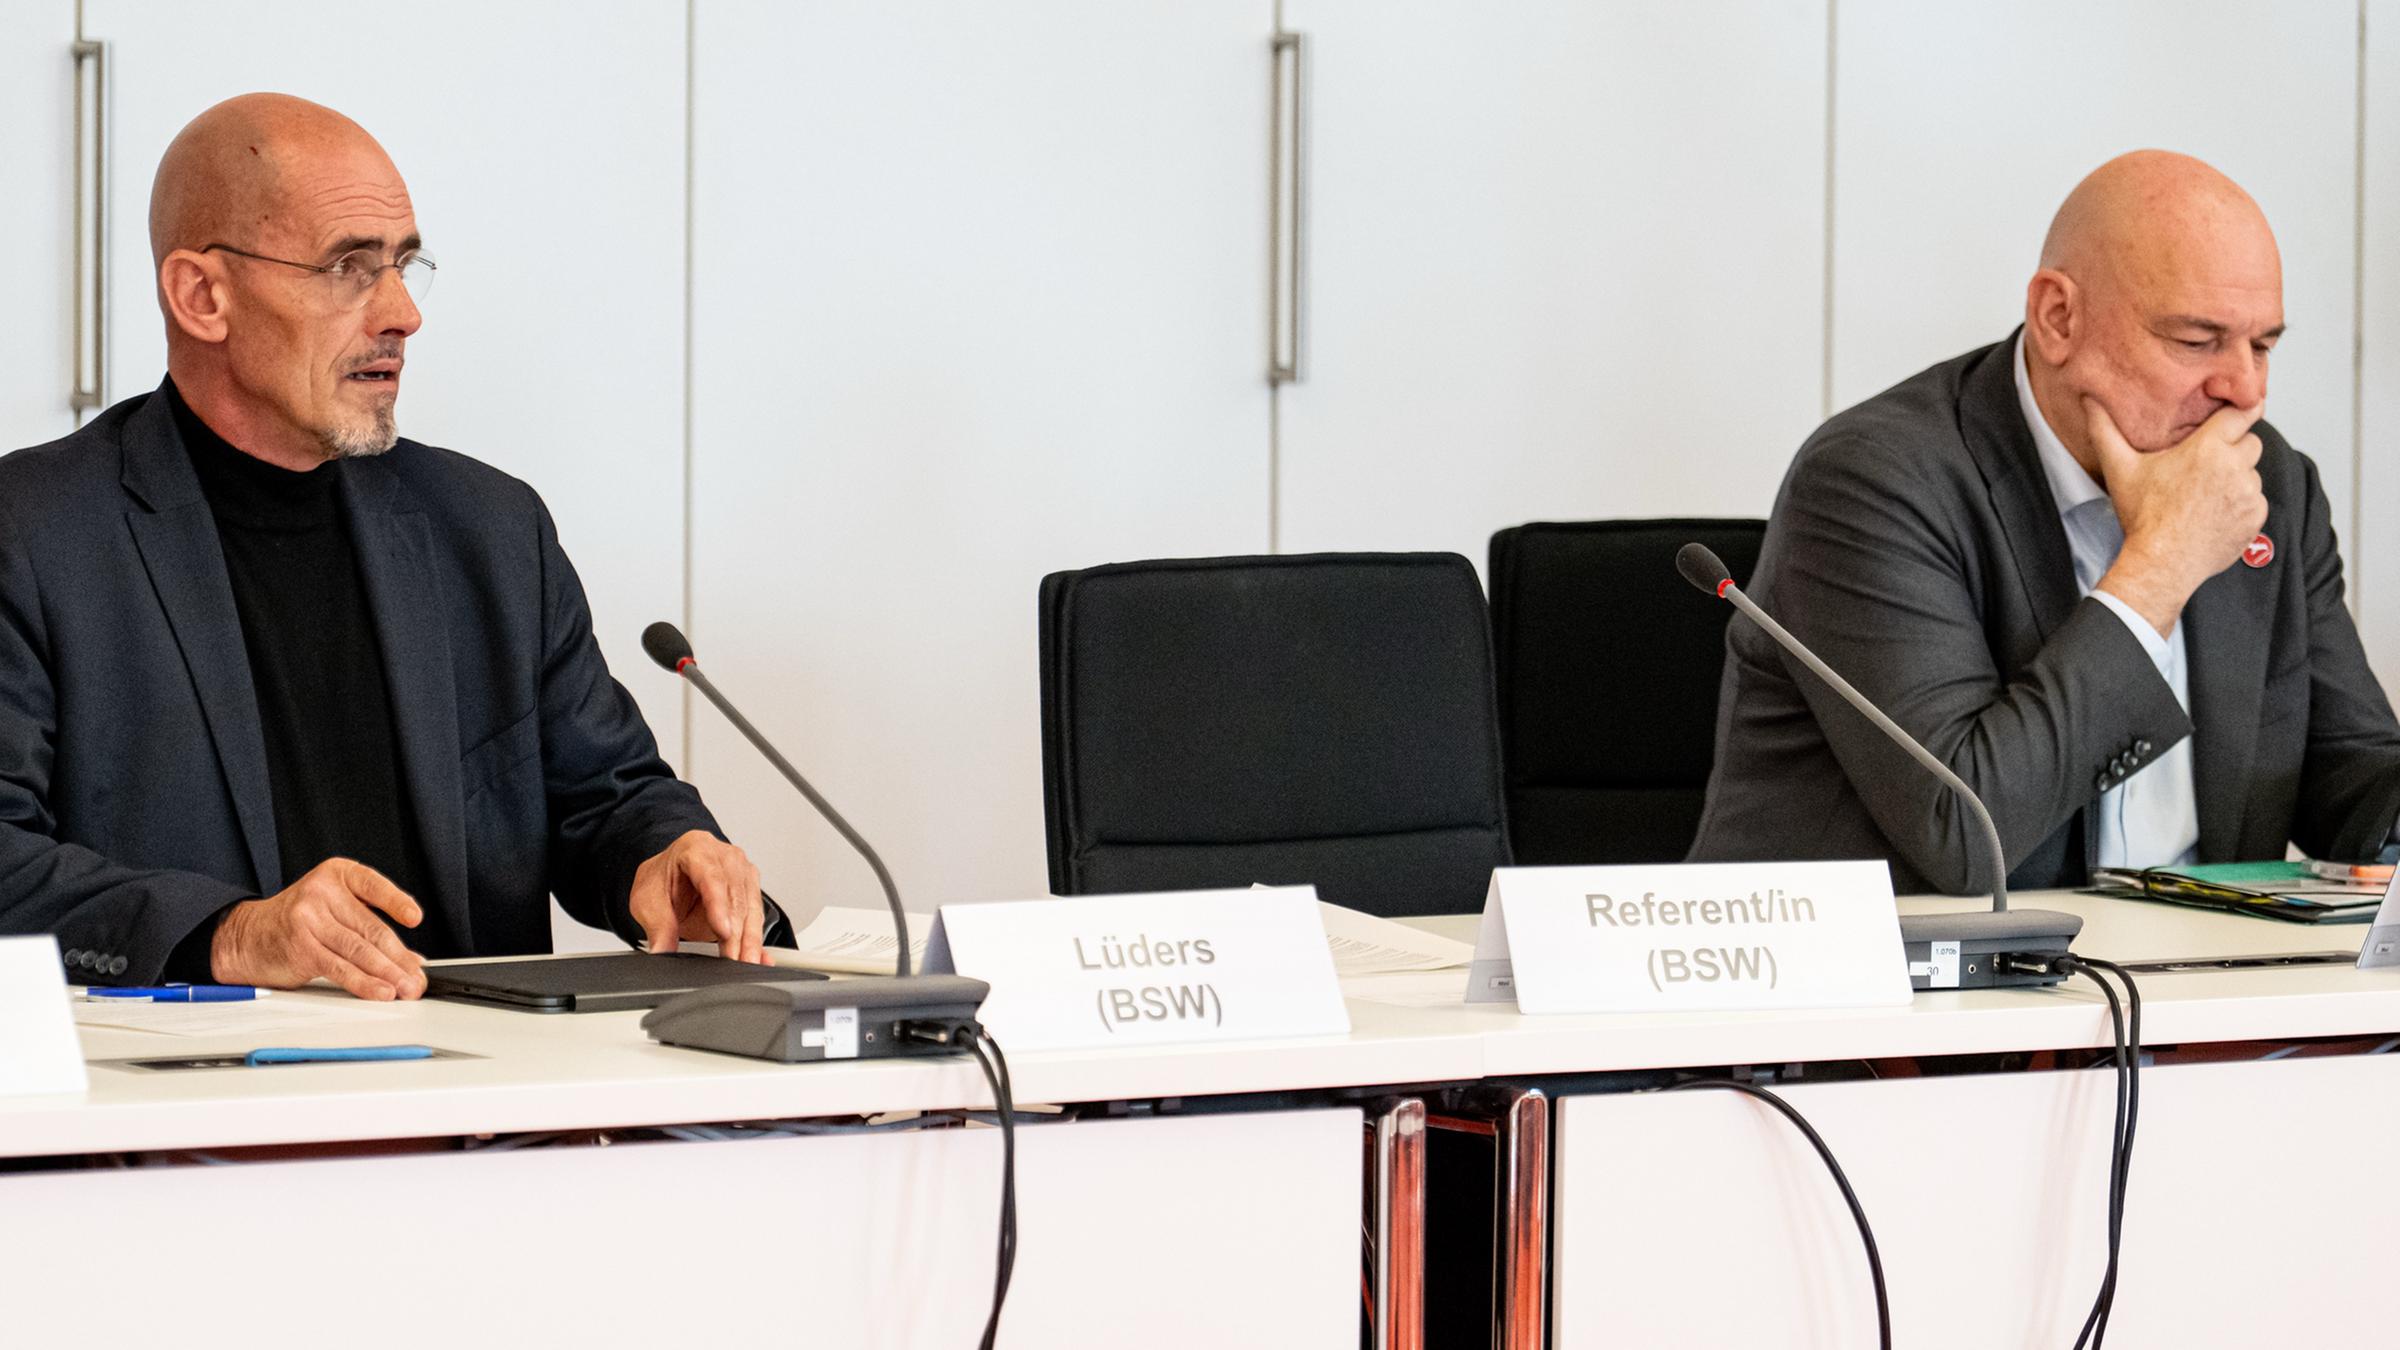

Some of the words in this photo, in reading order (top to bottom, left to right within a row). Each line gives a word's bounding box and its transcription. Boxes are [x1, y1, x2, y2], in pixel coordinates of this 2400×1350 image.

[1585, 889, 1816, 927] Referent/in
[1073, 933, 1215, 970] Lüders
[1647, 946, 1777, 992] (BSW)
[1097, 983, 1222, 1033] (BSW)
